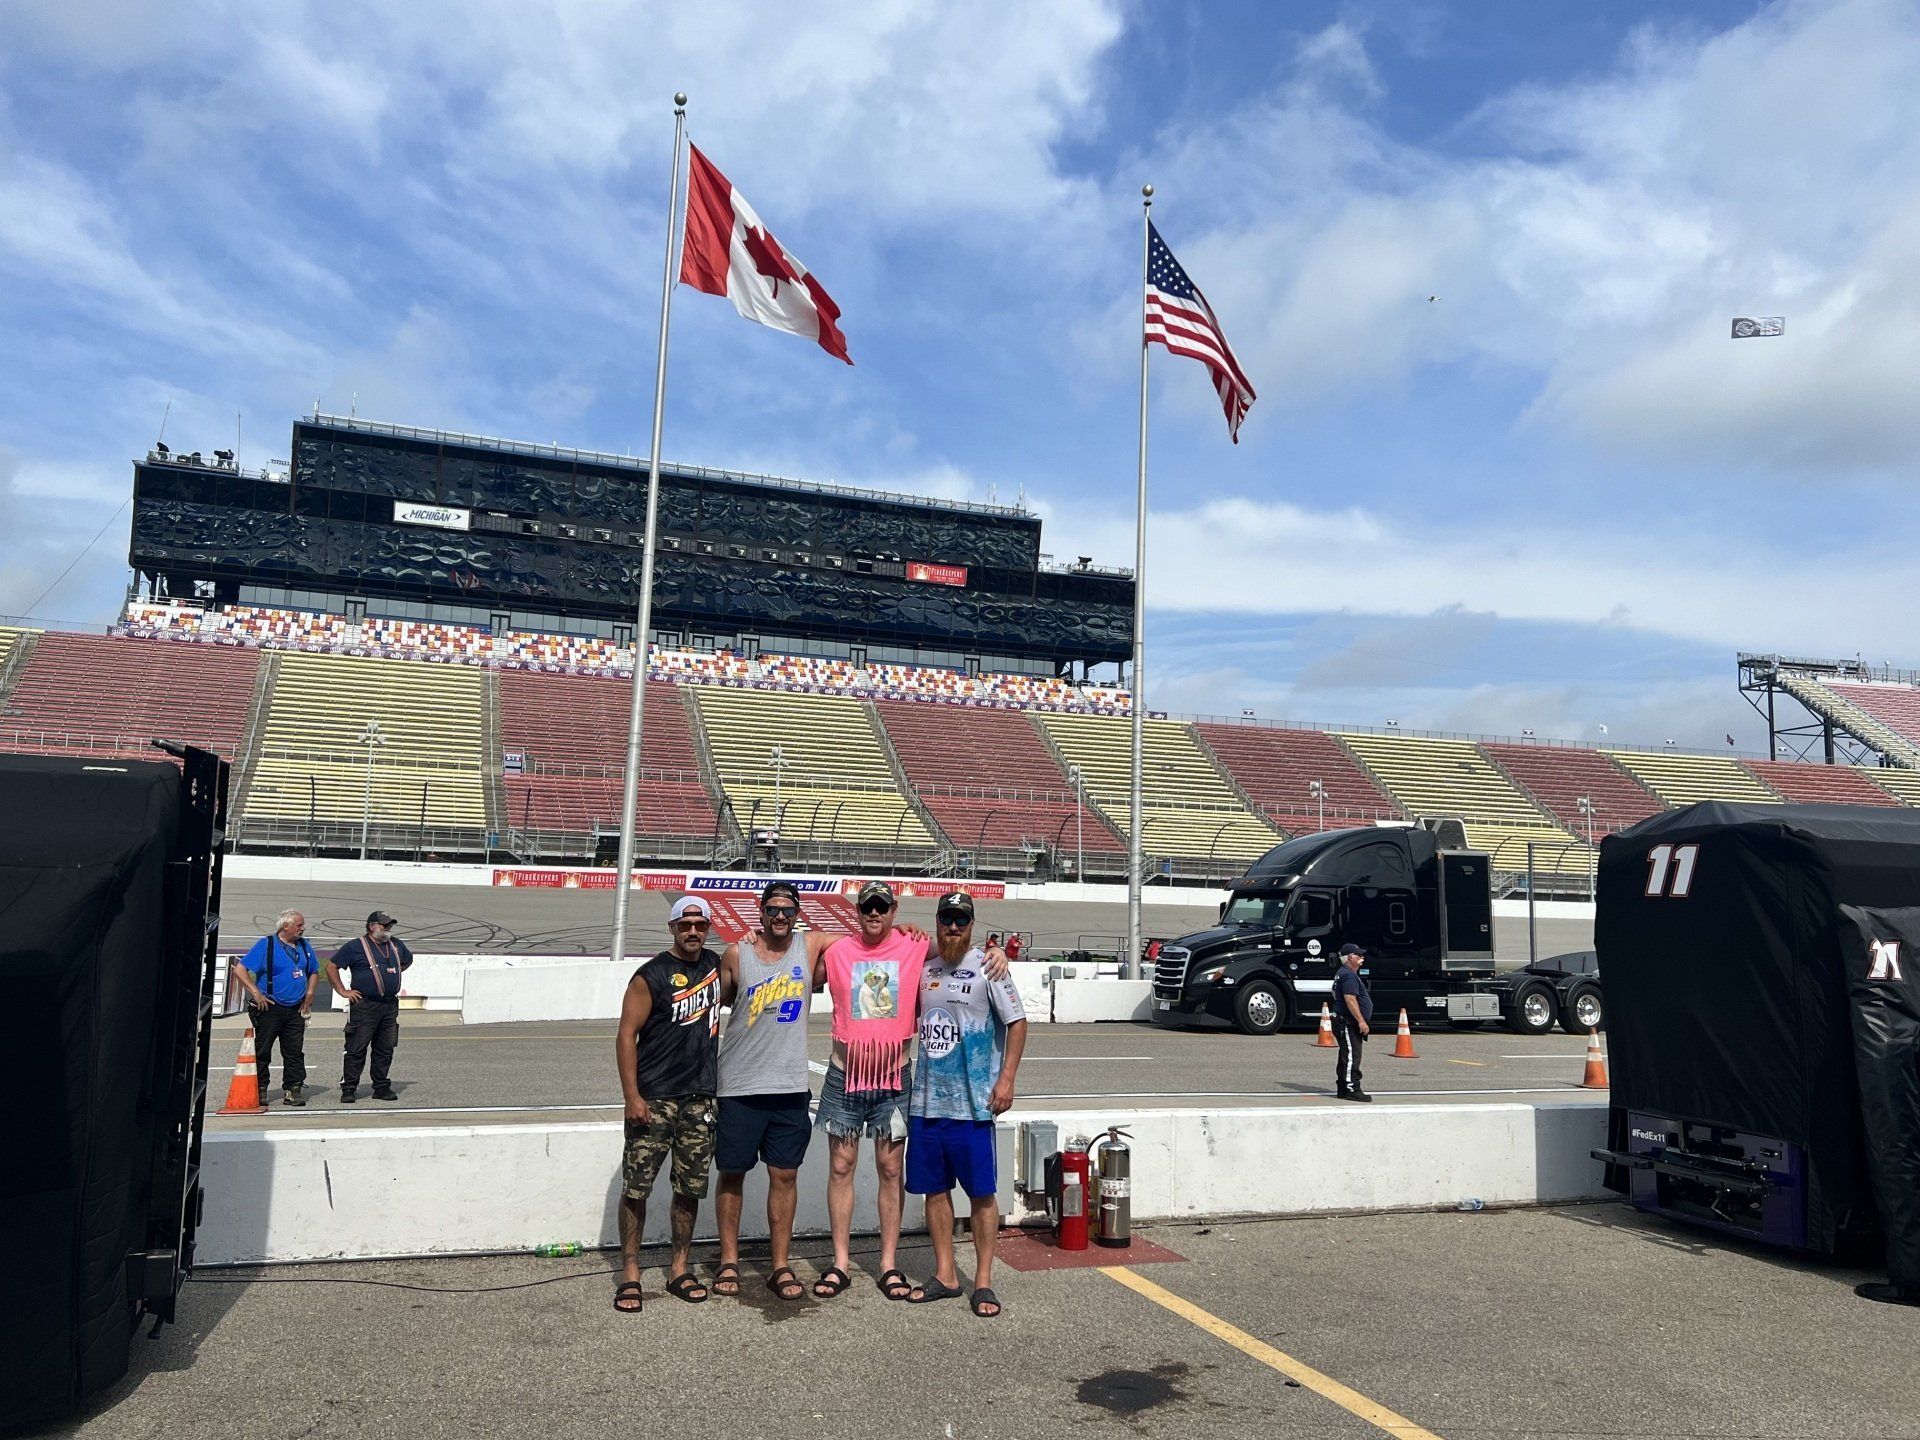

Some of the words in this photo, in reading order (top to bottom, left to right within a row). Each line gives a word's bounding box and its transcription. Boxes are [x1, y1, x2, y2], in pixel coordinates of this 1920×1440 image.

[410, 509, 451, 522] MICHIGAN
[134, 630, 150, 638] ally
[179, 635, 194, 643] ally
[223, 638, 238, 646] ally
[266, 640, 280, 649] ally
[307, 644, 322, 653] ally
[350, 648, 365, 656] ally
[390, 652, 405, 660] ally
[430, 655, 444, 663] ally
[469, 658, 483, 666] ally
[620, 671, 632, 679] ally
[655, 673, 668, 681] ally
[690, 677, 702, 685] ally
[1645, 844, 1700, 897] 11
[518, 872, 559, 882] FIREKEEPERS
[584, 874, 617, 883] FIREKEEPE
[698, 879, 815, 890] MISPEEDWom
[948, 894, 962, 904] 4
[776, 998, 803, 1024] 9
[920, 1024, 960, 1042] BUSCH
[927, 1042, 950, 1050] IGHT
[1632, 1128, 1665, 1142] #FedEx11
